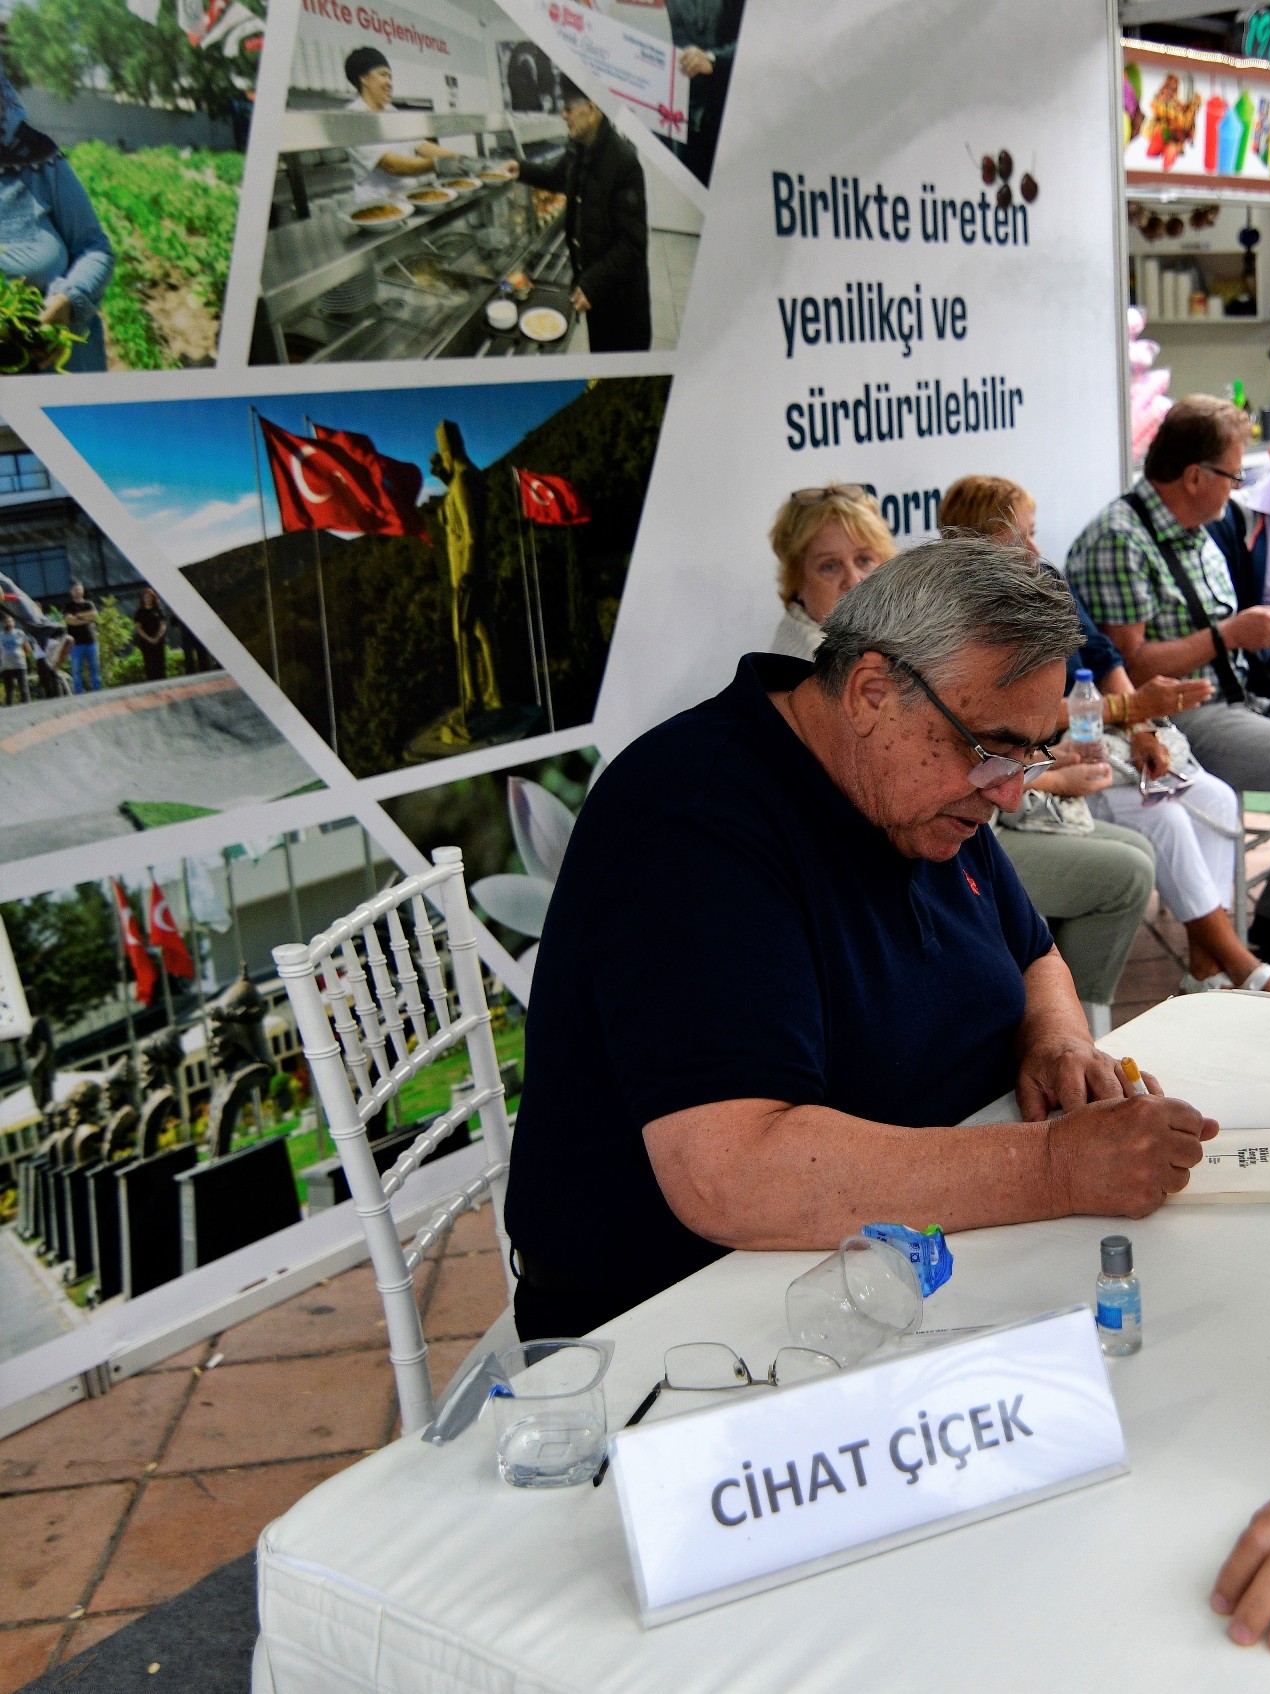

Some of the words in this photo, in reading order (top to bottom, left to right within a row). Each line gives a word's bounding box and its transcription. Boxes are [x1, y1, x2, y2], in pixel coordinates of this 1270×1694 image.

[772, 171, 911, 243] Birlikte
[921, 184, 1030, 247] üreten
[777, 282, 923, 358] yenilikçi
[931, 294, 969, 341] ve
[785, 376, 1025, 452] sürdürülebilir
[711, 1438, 871, 1527] CİHAT
[888, 1393, 1034, 1486] ÇİÇEK
